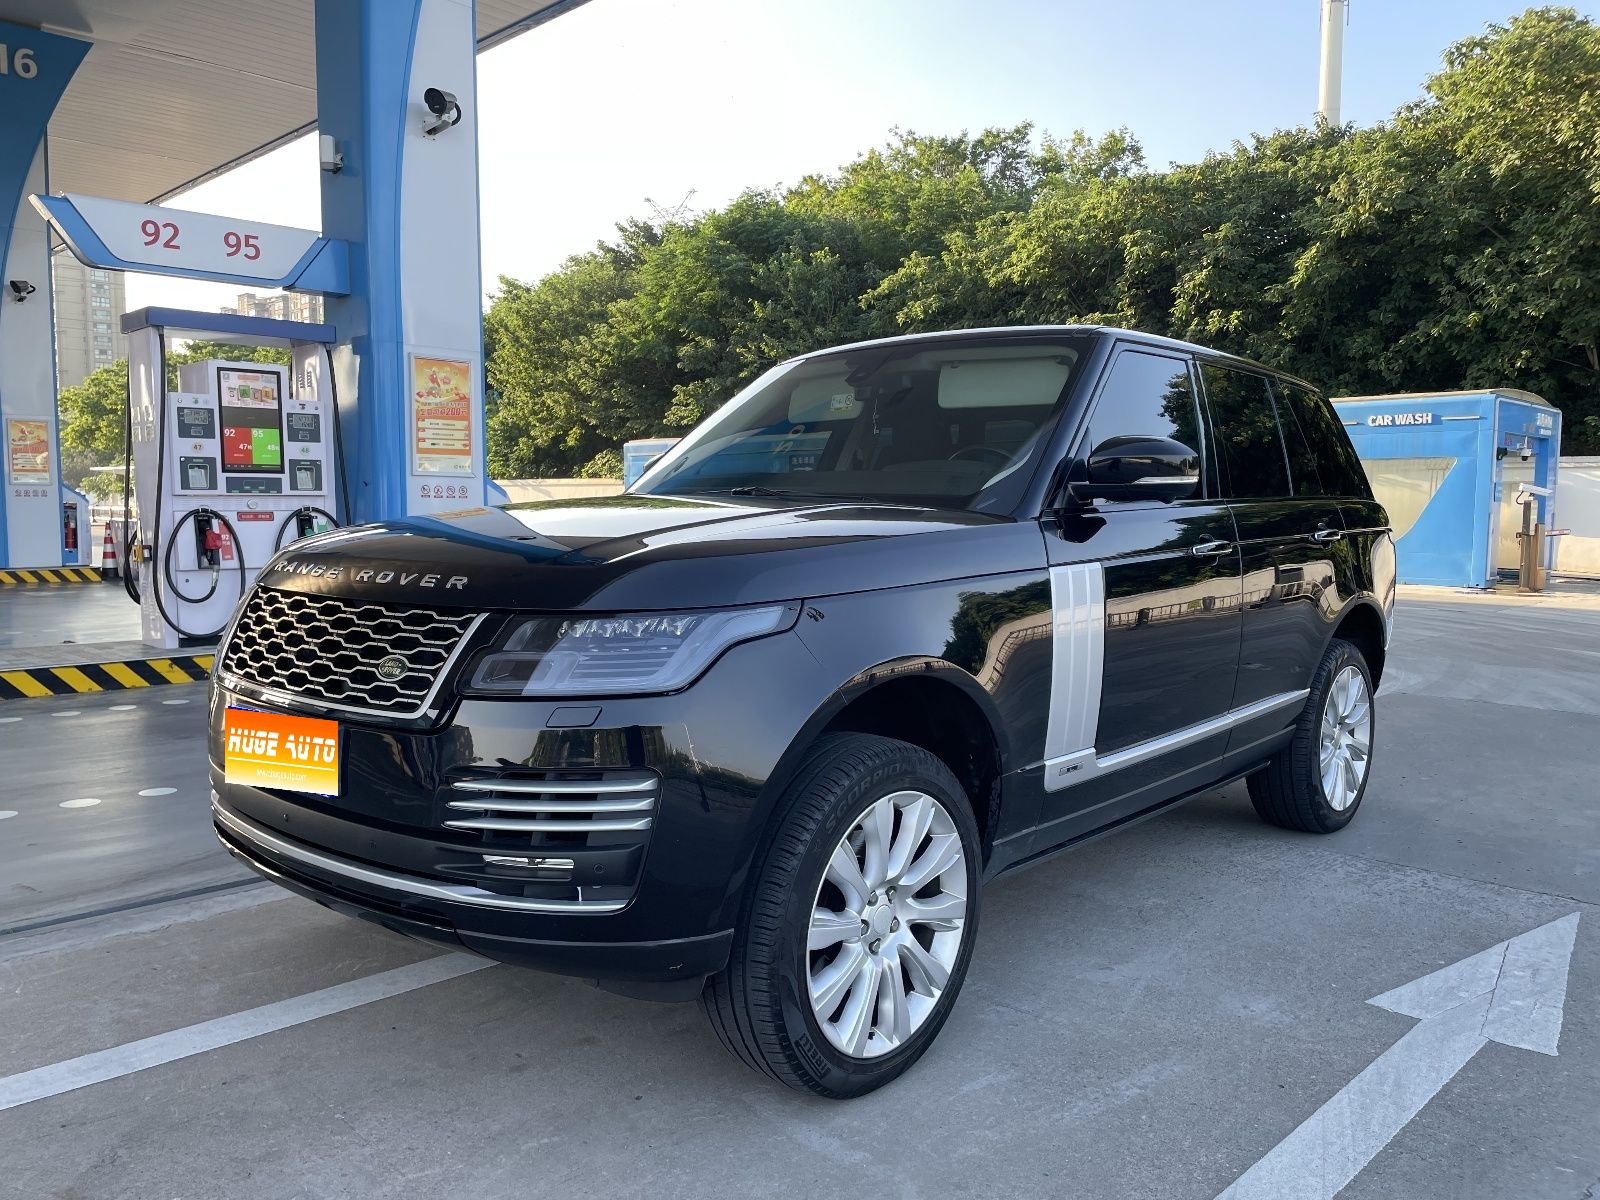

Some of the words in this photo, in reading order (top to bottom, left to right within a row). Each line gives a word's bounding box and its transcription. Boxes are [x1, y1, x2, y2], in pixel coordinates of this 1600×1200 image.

[141, 219, 181, 250] 92
[223, 231, 261, 261] 95
[1367, 415, 1393, 427] CAR
[1394, 412, 1433, 425] WASH
[224, 428, 236, 437] 92
[252, 430, 264, 438] 95
[274, 559, 343, 580] RANGE
[355, 568, 469, 590] ROVER
